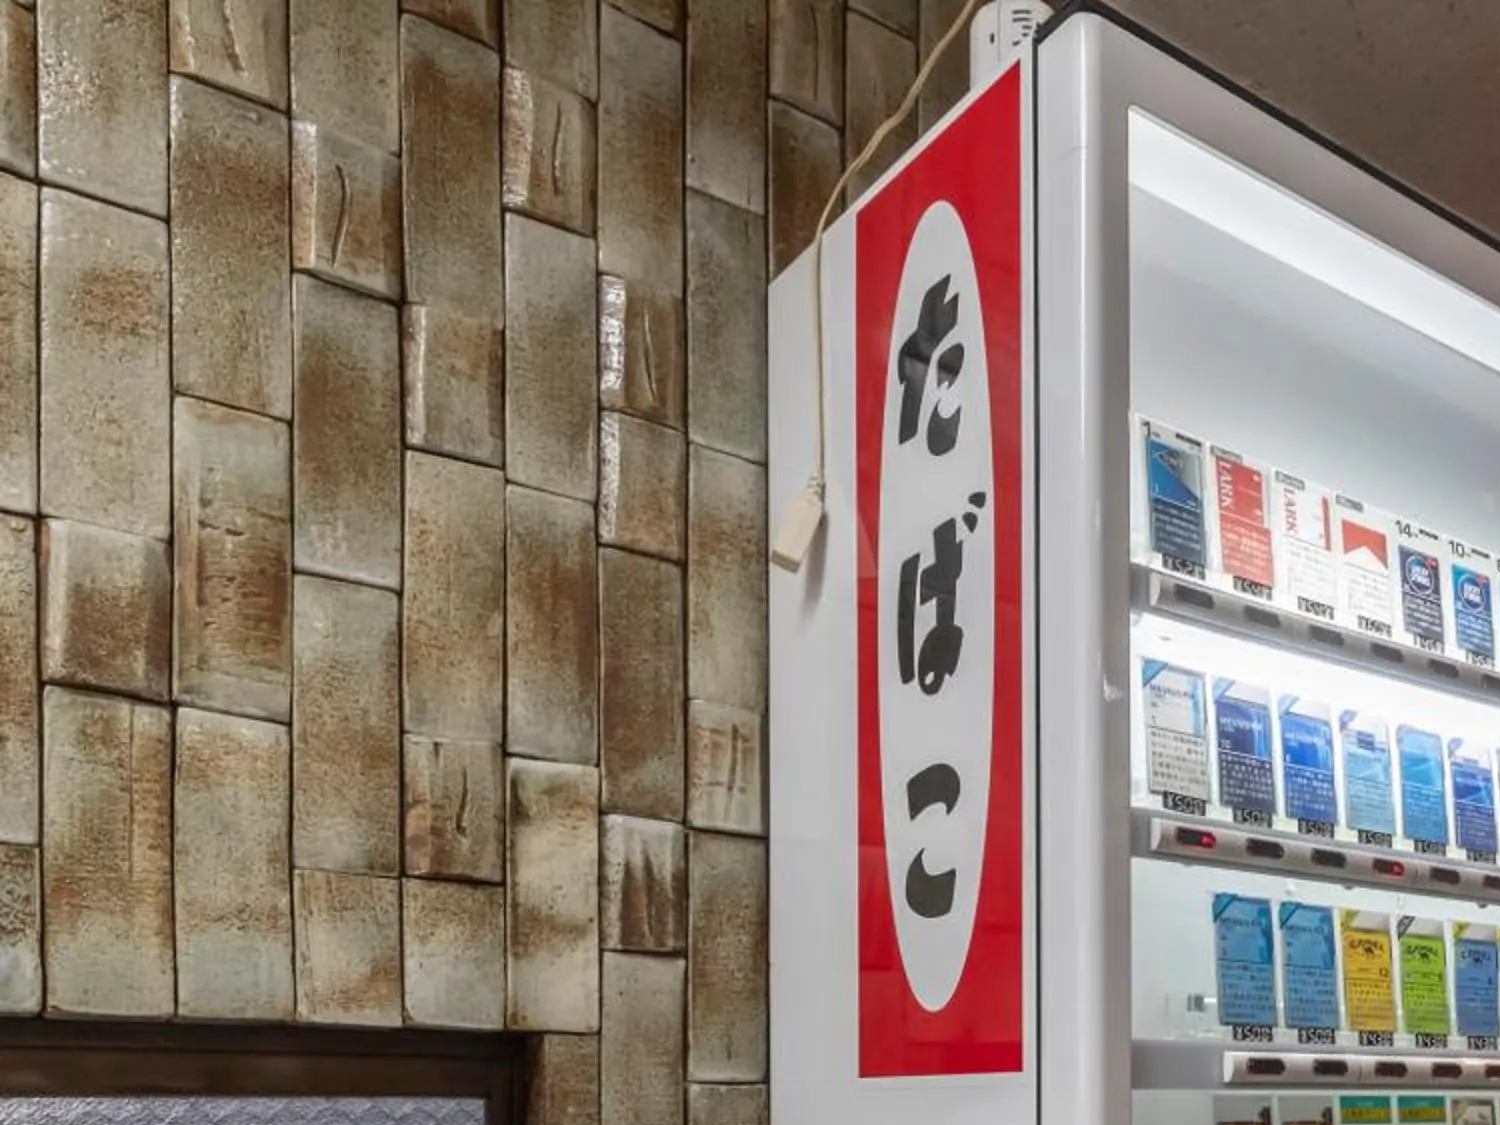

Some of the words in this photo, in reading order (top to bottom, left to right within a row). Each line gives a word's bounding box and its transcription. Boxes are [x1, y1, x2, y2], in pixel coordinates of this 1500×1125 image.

[1219, 460, 1234, 513] LARK
[1283, 487, 1299, 538] LARK
[896, 273, 986, 919] たばこ
